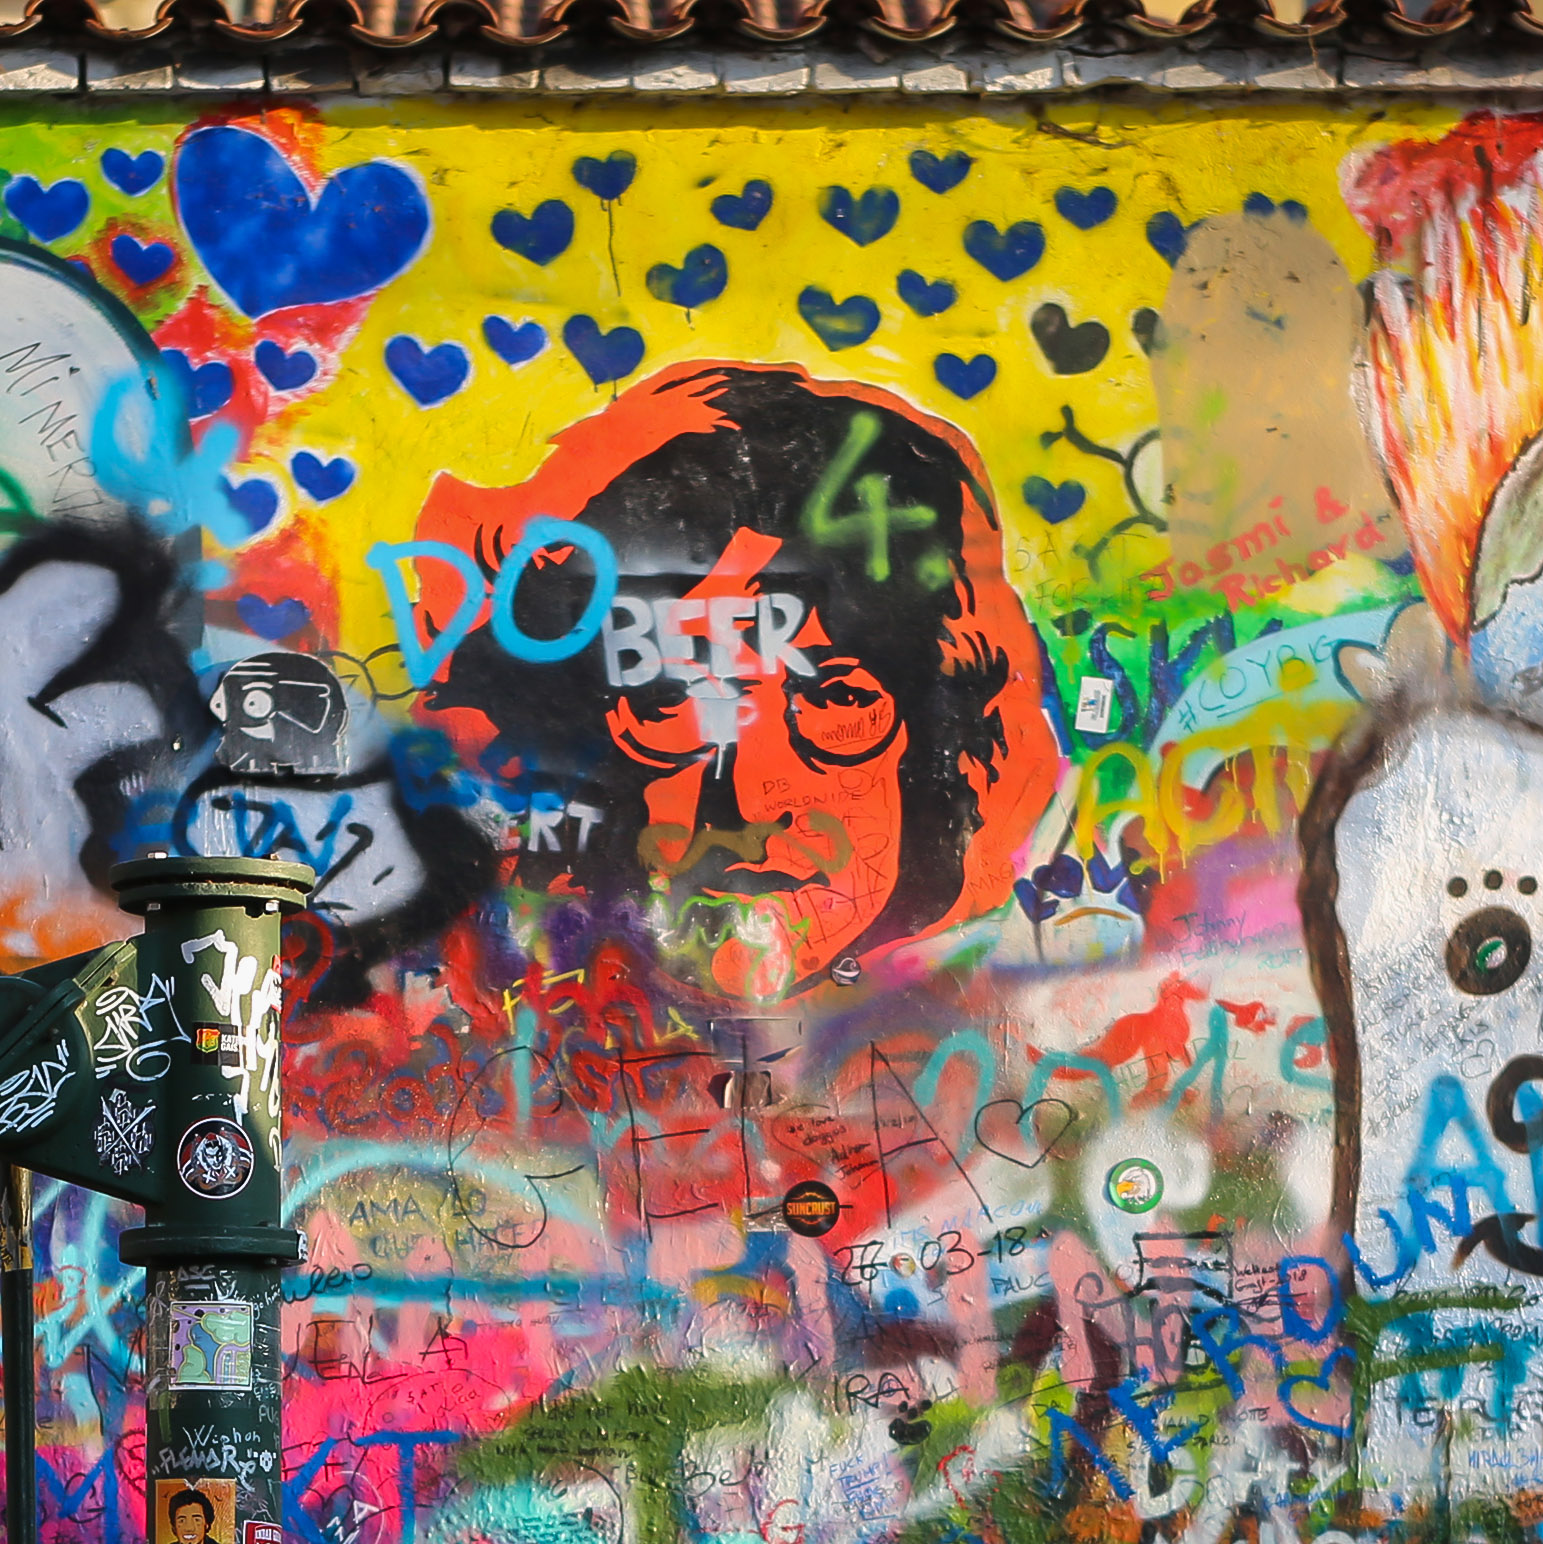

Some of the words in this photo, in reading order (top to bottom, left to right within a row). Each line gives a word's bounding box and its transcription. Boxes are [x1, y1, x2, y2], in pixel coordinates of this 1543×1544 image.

[368, 513, 618, 688] DO
[603, 593, 819, 688] BEER
[786, 1202, 836, 1216] SUNCRUST
